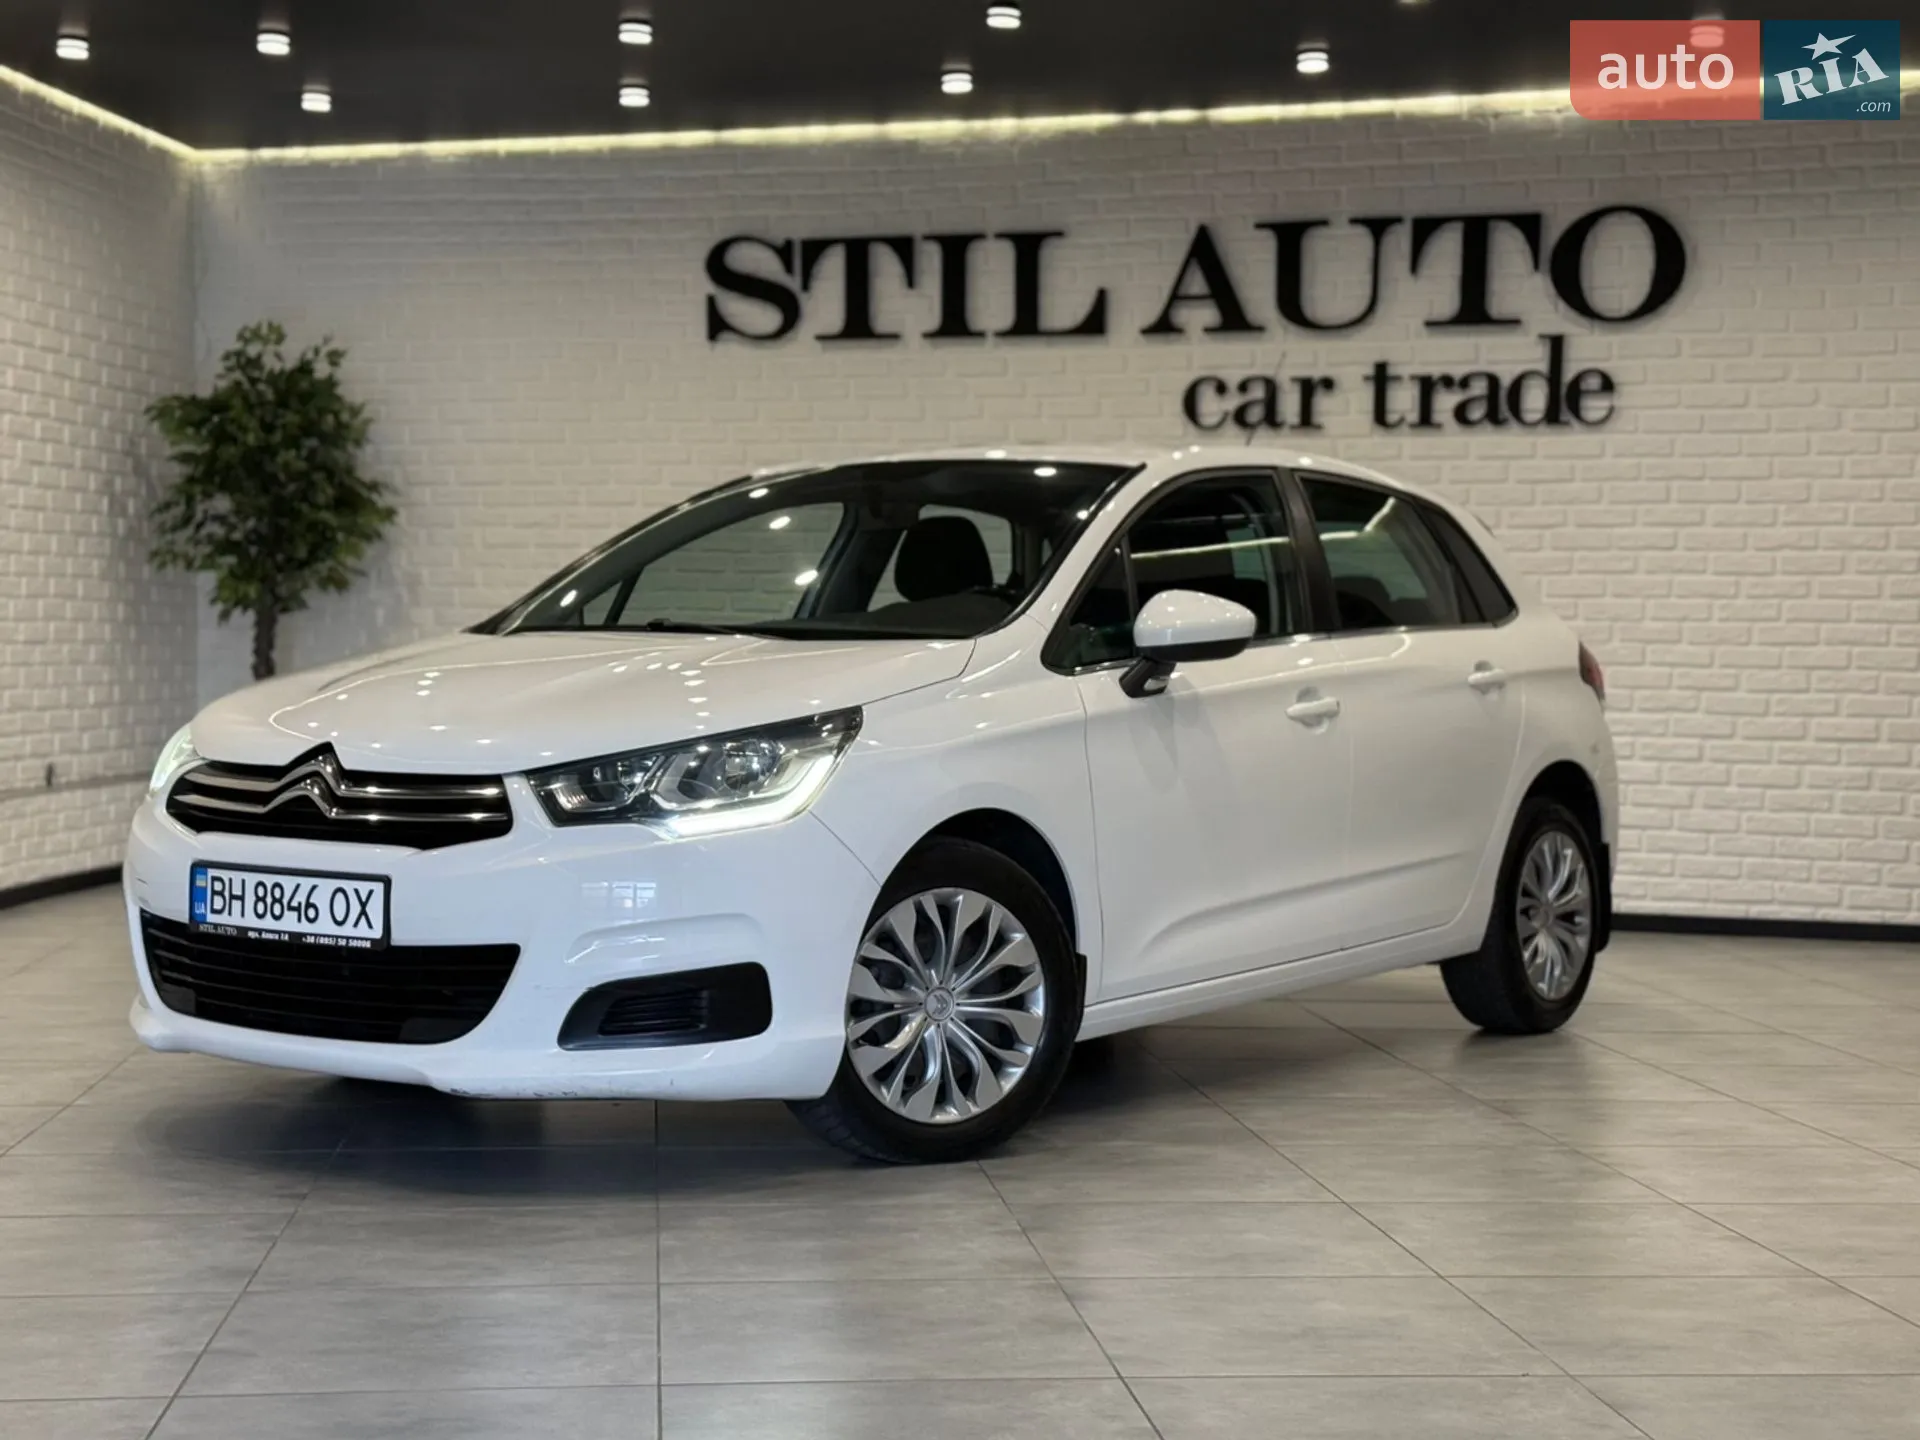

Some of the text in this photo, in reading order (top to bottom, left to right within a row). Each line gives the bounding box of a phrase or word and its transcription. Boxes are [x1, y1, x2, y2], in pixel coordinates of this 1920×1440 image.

[705, 204, 1688, 342] STIL AUTO
[1183, 334, 1615, 431] car trade
[194, 902, 207, 915] UA
[210, 875, 375, 930] BH 8846 OX
